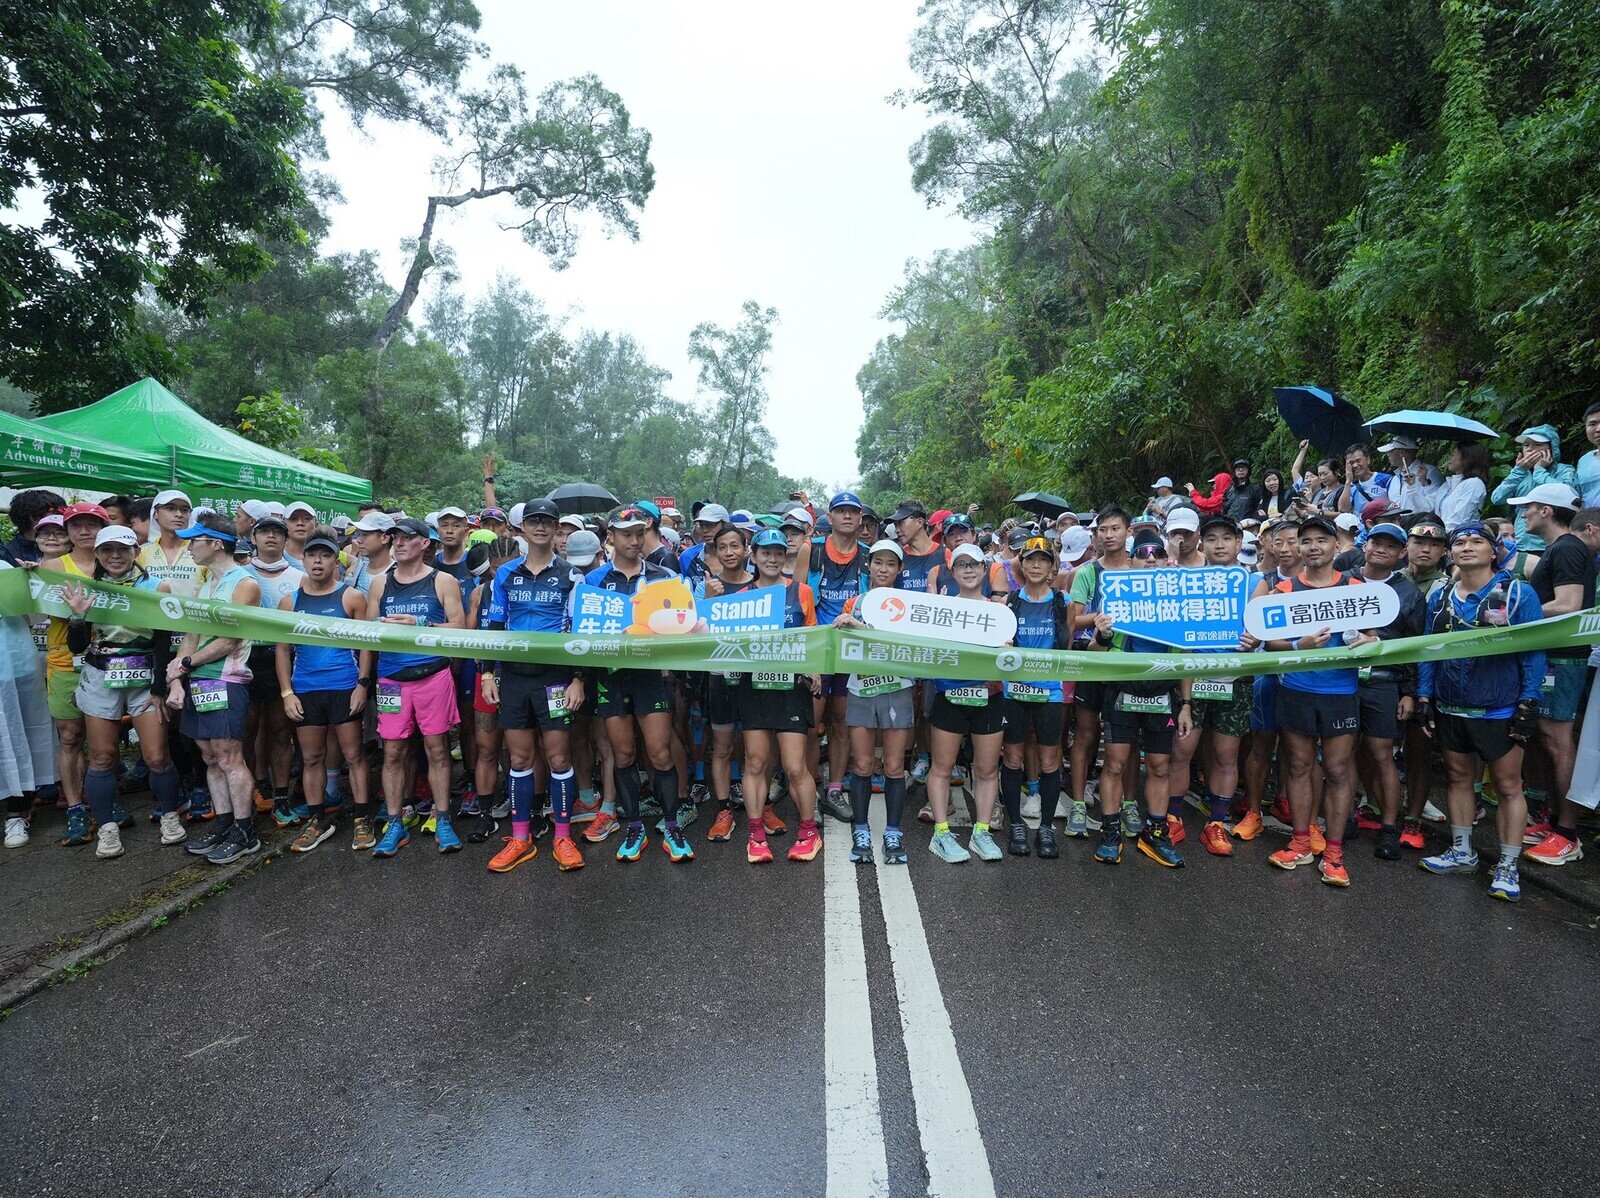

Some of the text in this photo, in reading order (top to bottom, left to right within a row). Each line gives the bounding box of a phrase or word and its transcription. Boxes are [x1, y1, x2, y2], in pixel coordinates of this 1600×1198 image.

[4, 448, 99, 474] Adventure Corps
[257, 477, 275, 489] Hong
[275, 479, 291, 491] Kong
[145, 565, 197, 574] Champion
[1106, 571, 1244, 597] 不可能任務?
[43, 584, 131, 612] 富證券
[581, 592, 625, 617] 富途
[1106, 597, 1238, 623] 我哋做得到!
[1290, 596, 1381, 624] 富途證券
[910, 604, 996, 633] 富途牛牛
[577, 618, 622, 635] 牛牛
[592, 643, 620, 651] OXFAM
[748, 641, 806, 655] OXFAM
[868, 642, 959, 666] 富途證券
[750, 653, 806, 661] TRAILWALKER
[1024, 661, 1053, 669] OXFAM
[110, 670, 147, 679] 8126C
[757, 672, 789, 681] 8081B
[863, 674, 895, 688] 8081D
[950, 686, 983, 698] 8081C
[1012, 684, 1044, 694] 8081A
[1194, 683, 1227, 692] 8080A
[1130, 695, 1163, 705] 8080C
